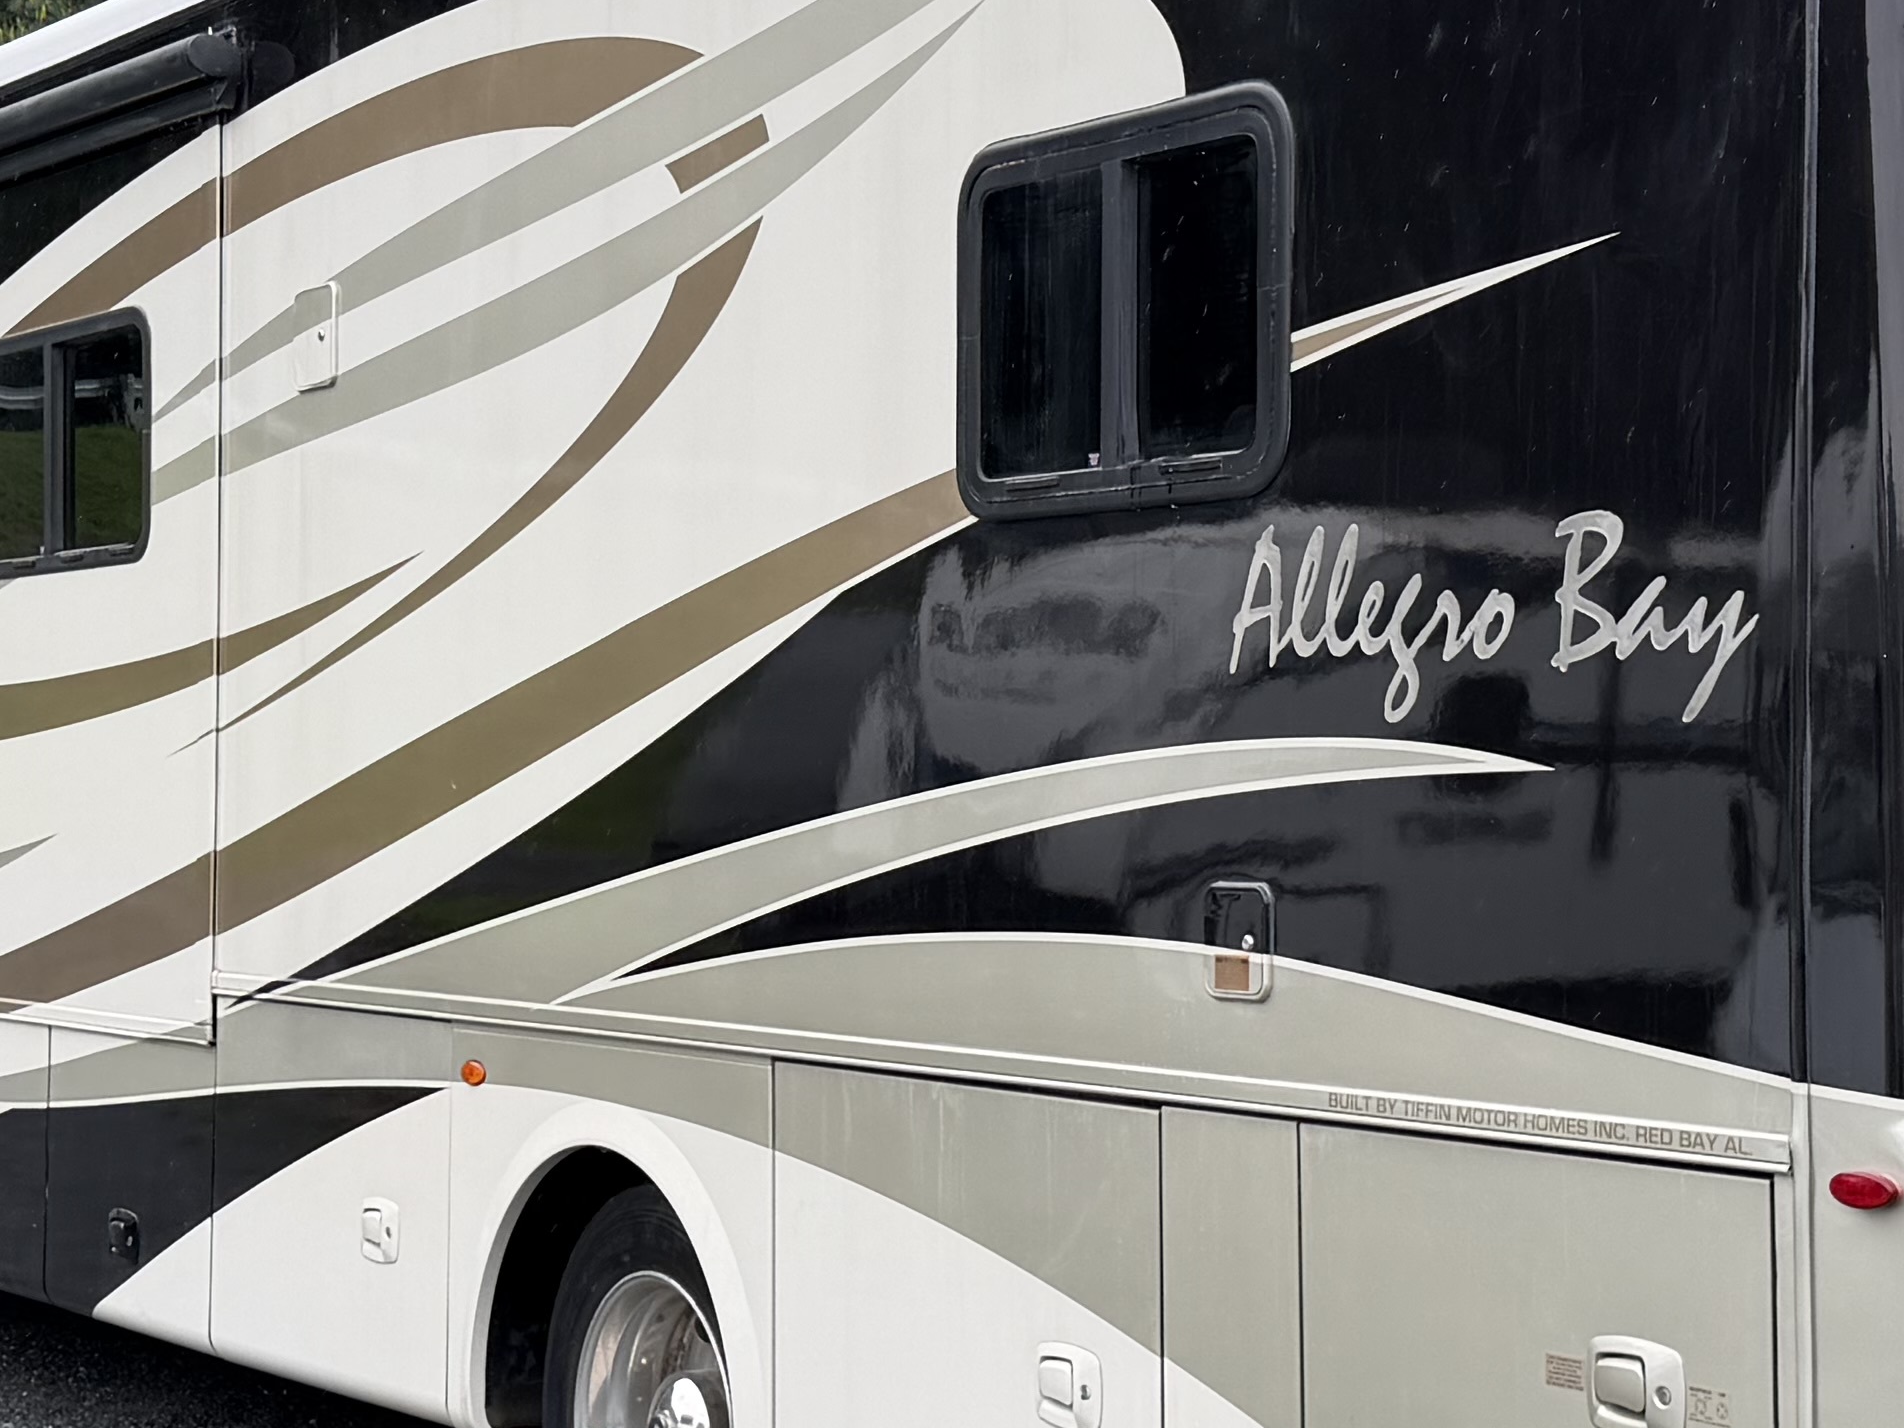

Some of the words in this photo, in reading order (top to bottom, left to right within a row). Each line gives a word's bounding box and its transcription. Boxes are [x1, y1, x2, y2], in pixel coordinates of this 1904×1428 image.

[1229, 523, 1516, 723] Allegro
[1550, 509, 1760, 723] Bay
[1328, 1091, 1372, 1112] BUILT
[1376, 1097, 1396, 1115] BY
[1403, 1100, 1451, 1121] TIFFIN
[1456, 1106, 1518, 1128] MOTOR
[1523, 1112, 1588, 1136] HOMES
[1594, 1120, 1630, 1142] INC.
[1635, 1125, 1673, 1146] RED
[1679, 1129, 1719, 1151] BAY
